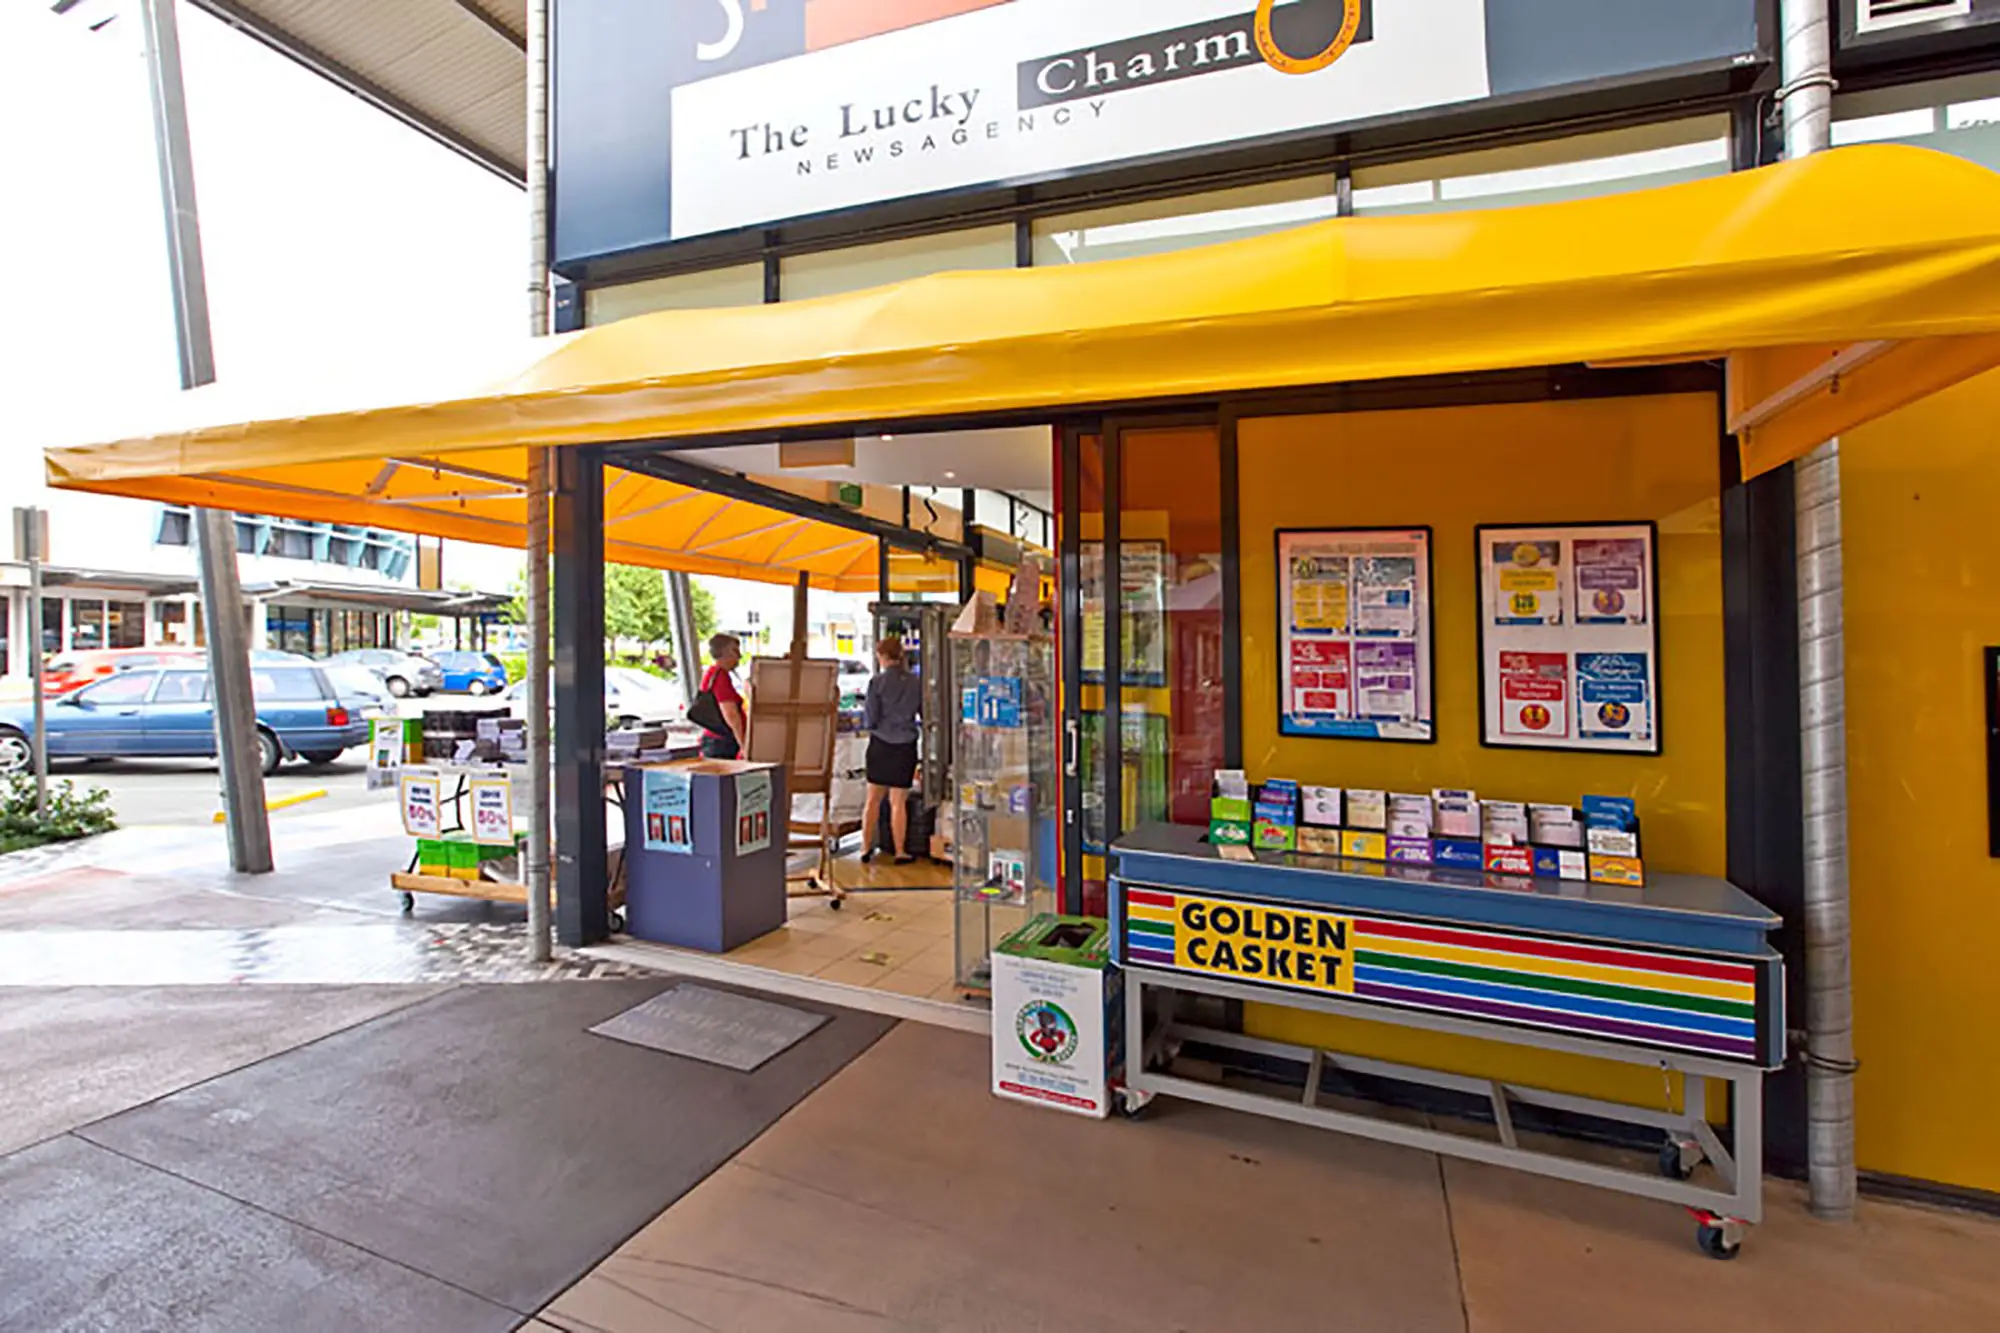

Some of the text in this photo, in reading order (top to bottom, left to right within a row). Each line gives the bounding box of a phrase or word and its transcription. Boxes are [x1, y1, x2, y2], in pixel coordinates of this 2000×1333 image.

[730, 121, 809, 161] The
[837, 83, 982, 139] Lucky
[1036, 26, 1252, 96] Charm
[796, 99, 1107, 176] NEWSAGENCY
[1181, 901, 1347, 951] GOLDEN
[1186, 937, 1343, 986] CASKET
